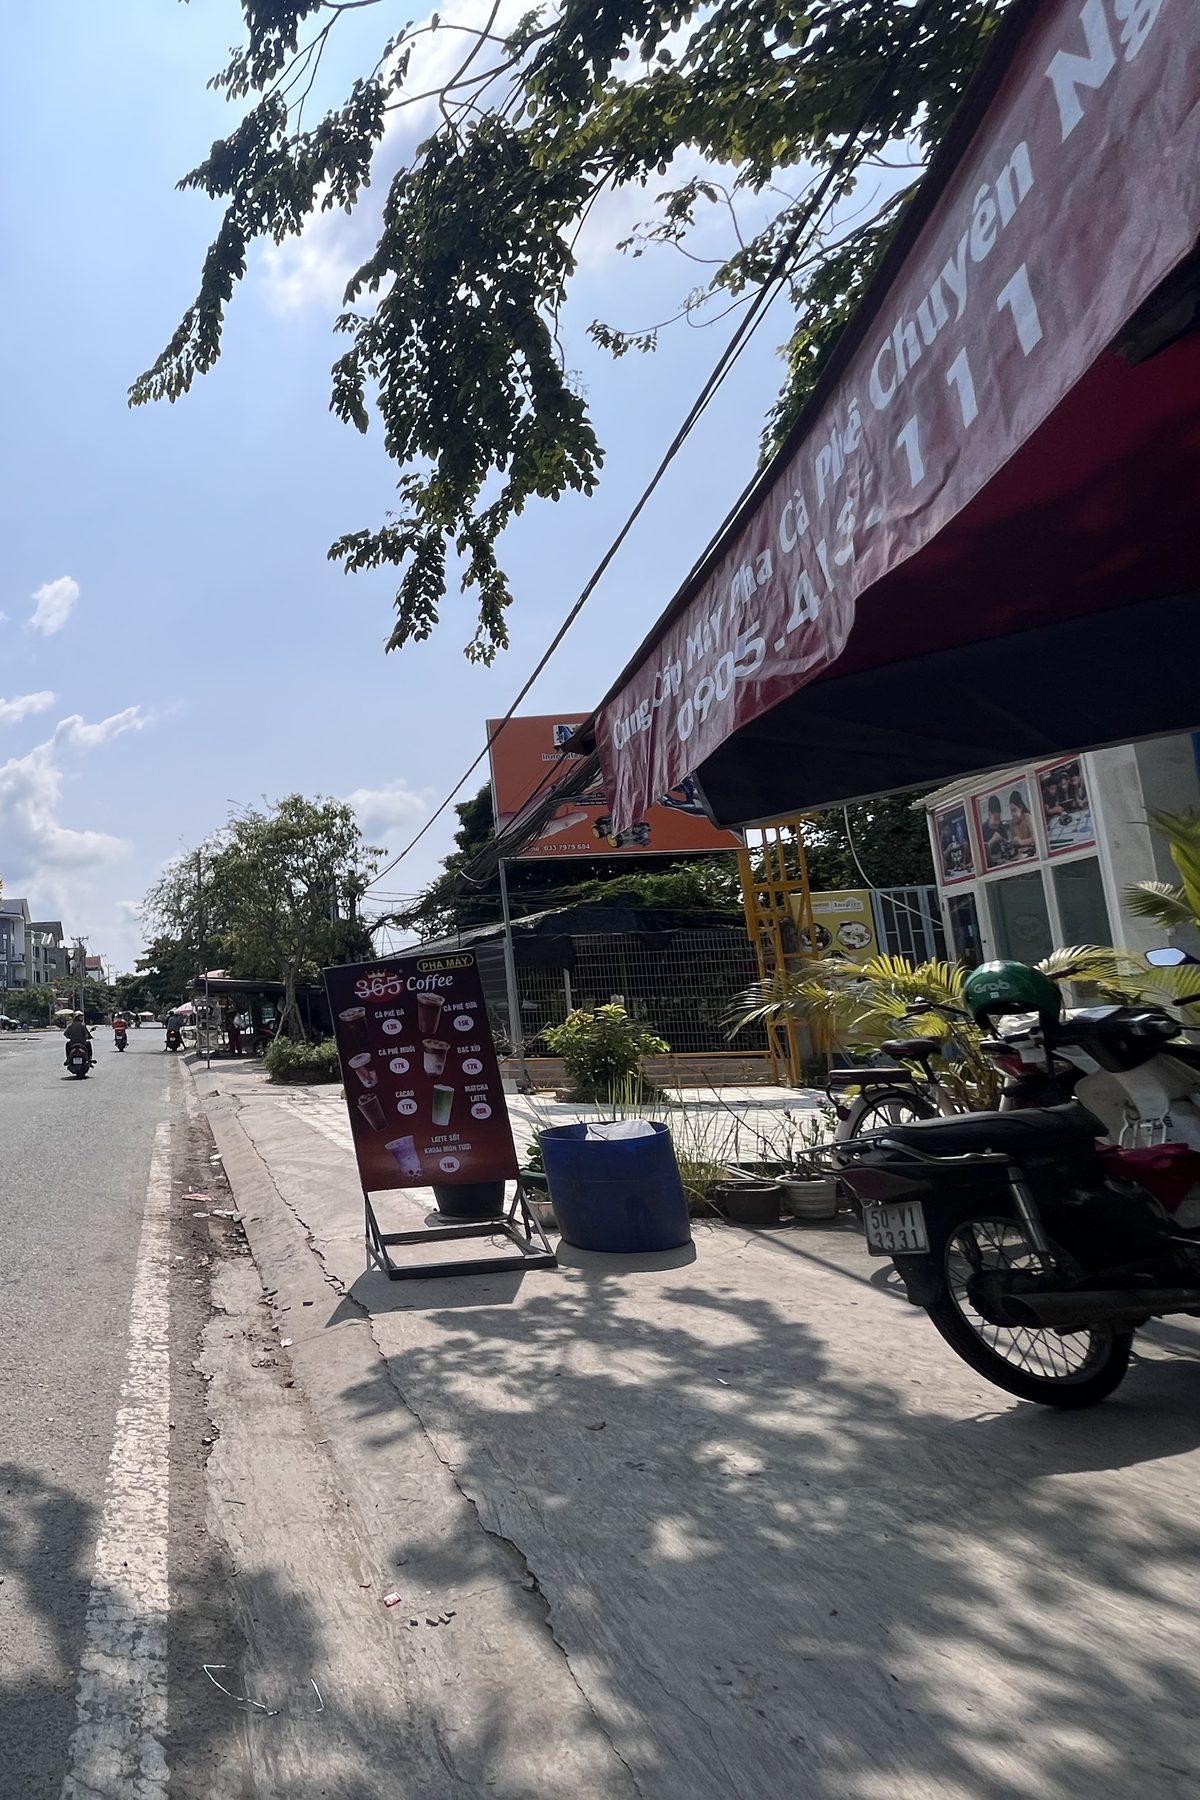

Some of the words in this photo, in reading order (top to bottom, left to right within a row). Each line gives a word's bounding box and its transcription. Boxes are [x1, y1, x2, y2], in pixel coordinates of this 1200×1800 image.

[613, 698, 652, 750] Cung
[730, 549, 773, 620] Pha
[779, 489, 810, 553] Cà
[869, 141, 1035, 410] Chuyên
[421, 960, 444, 971] PHA
[406, 974, 454, 992] Coffee
[973, 979, 1010, 993] Grab
[464, 1083, 489, 1092] MATCHA
[395, 1089, 415, 1098] CACAO
[470, 1094, 488, 1103] LATTE
[431, 1135, 448, 1143] LATTE
